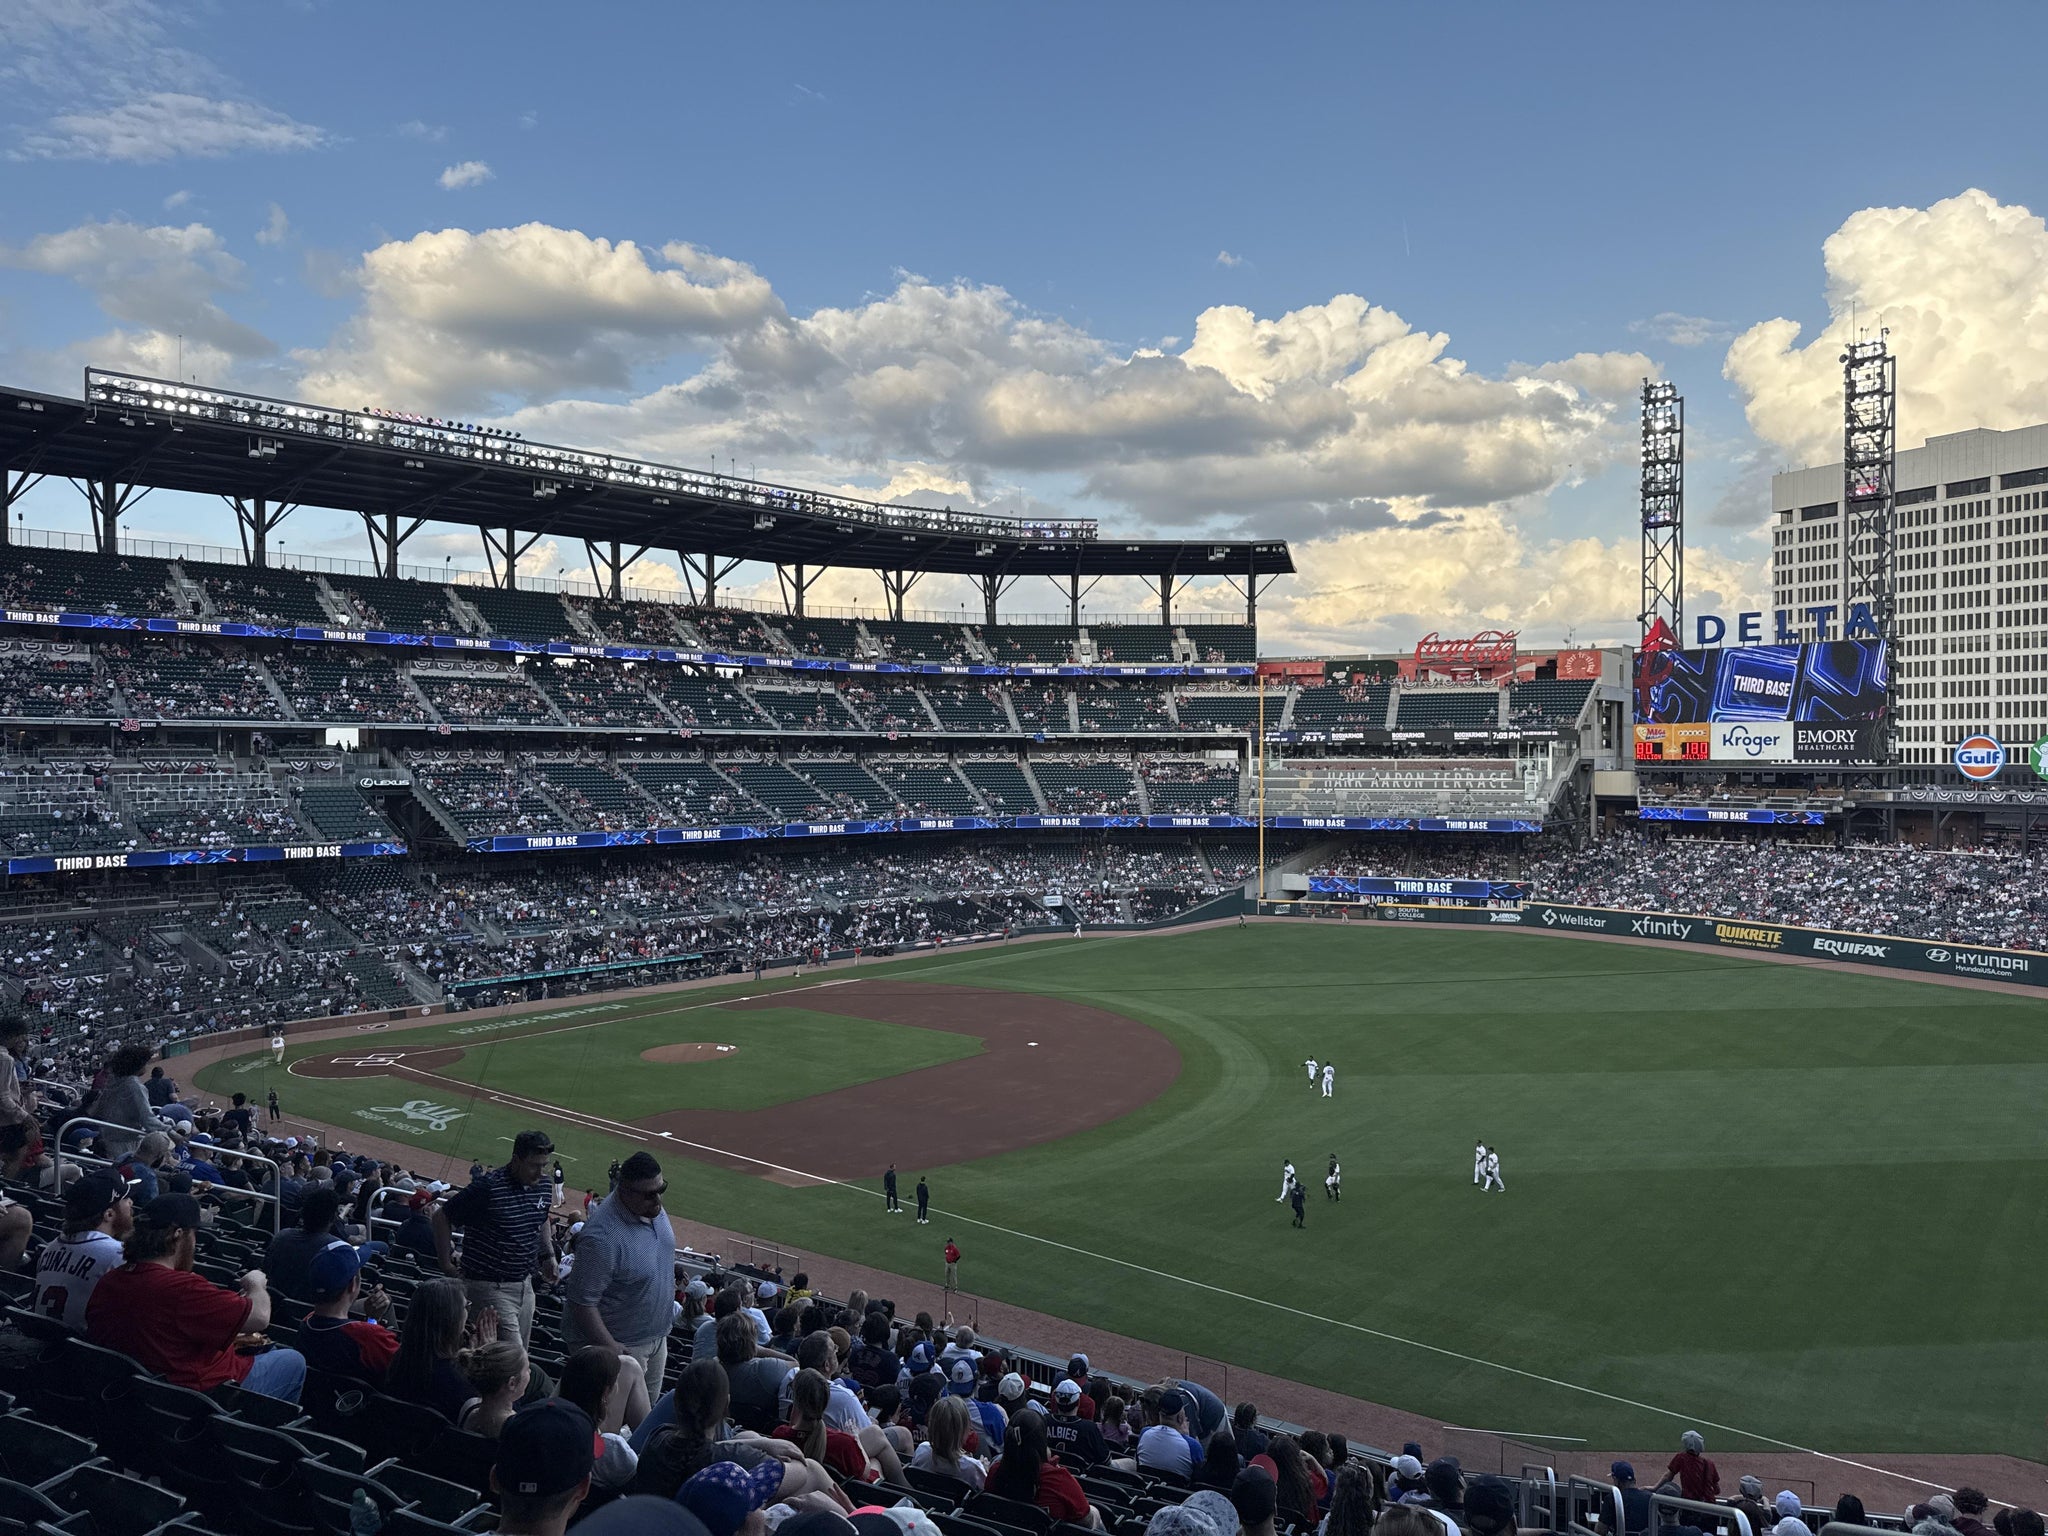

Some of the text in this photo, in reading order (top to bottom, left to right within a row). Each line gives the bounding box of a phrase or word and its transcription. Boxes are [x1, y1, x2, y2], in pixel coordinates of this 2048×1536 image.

[6, 612, 60, 624] THIRD BASE
[1697, 603, 1880, 644] DELTA
[177, 622, 221, 632] THIRD BASE
[323, 631, 366, 641] THIRD BASE
[455, 639, 490, 648] THIRD BASE
[590, 647, 605, 655] BASE
[1734, 675, 1791, 697] THIRD BASE
[121, 718, 140, 731] 35
[1723, 725, 1780, 756] Kroger
[1797, 730, 1858, 743] EMORY
[1636, 742, 1652, 754] 80
[1686, 742, 1708, 754] 180
[1958, 750, 2001, 764] Gulf
[1324, 771, 1507, 788] HANK AARON TERRACE
[1708, 811, 1748, 820] THIRD BASE
[809, 824, 845, 833] THIRD BASE
[937, 820, 954, 828] BASE
[1326, 819, 1345, 827] BASE
[1446, 821, 1488, 830] THIRD BASE
[682, 829, 721, 840] THIRD BASE
[527, 836, 577, 847] THIRD BASE
[284, 846, 341, 859] THIRD BASE
[55, 855, 127, 870] THIRD BASE
[1394, 881, 1452, 893] THIRD BASE
[1371, 895, 1399, 904] MLB+
[1440, 898, 1470, 906] MLB+
[1559, 913, 1607, 928] Wellstar
[1631, 916, 1692, 939] xfinity
[1715, 924, 1783, 944] QUIKRETE
[1813, 938, 1888, 957] EQUIFAX
[1955, 952, 2028, 971] HYUNDAI
[1955, 964, 2012, 977] HyundaiUSA.com
[70, 1254, 96, 1281] JR.
[1046, 1426, 1078, 1442] ALBIES
